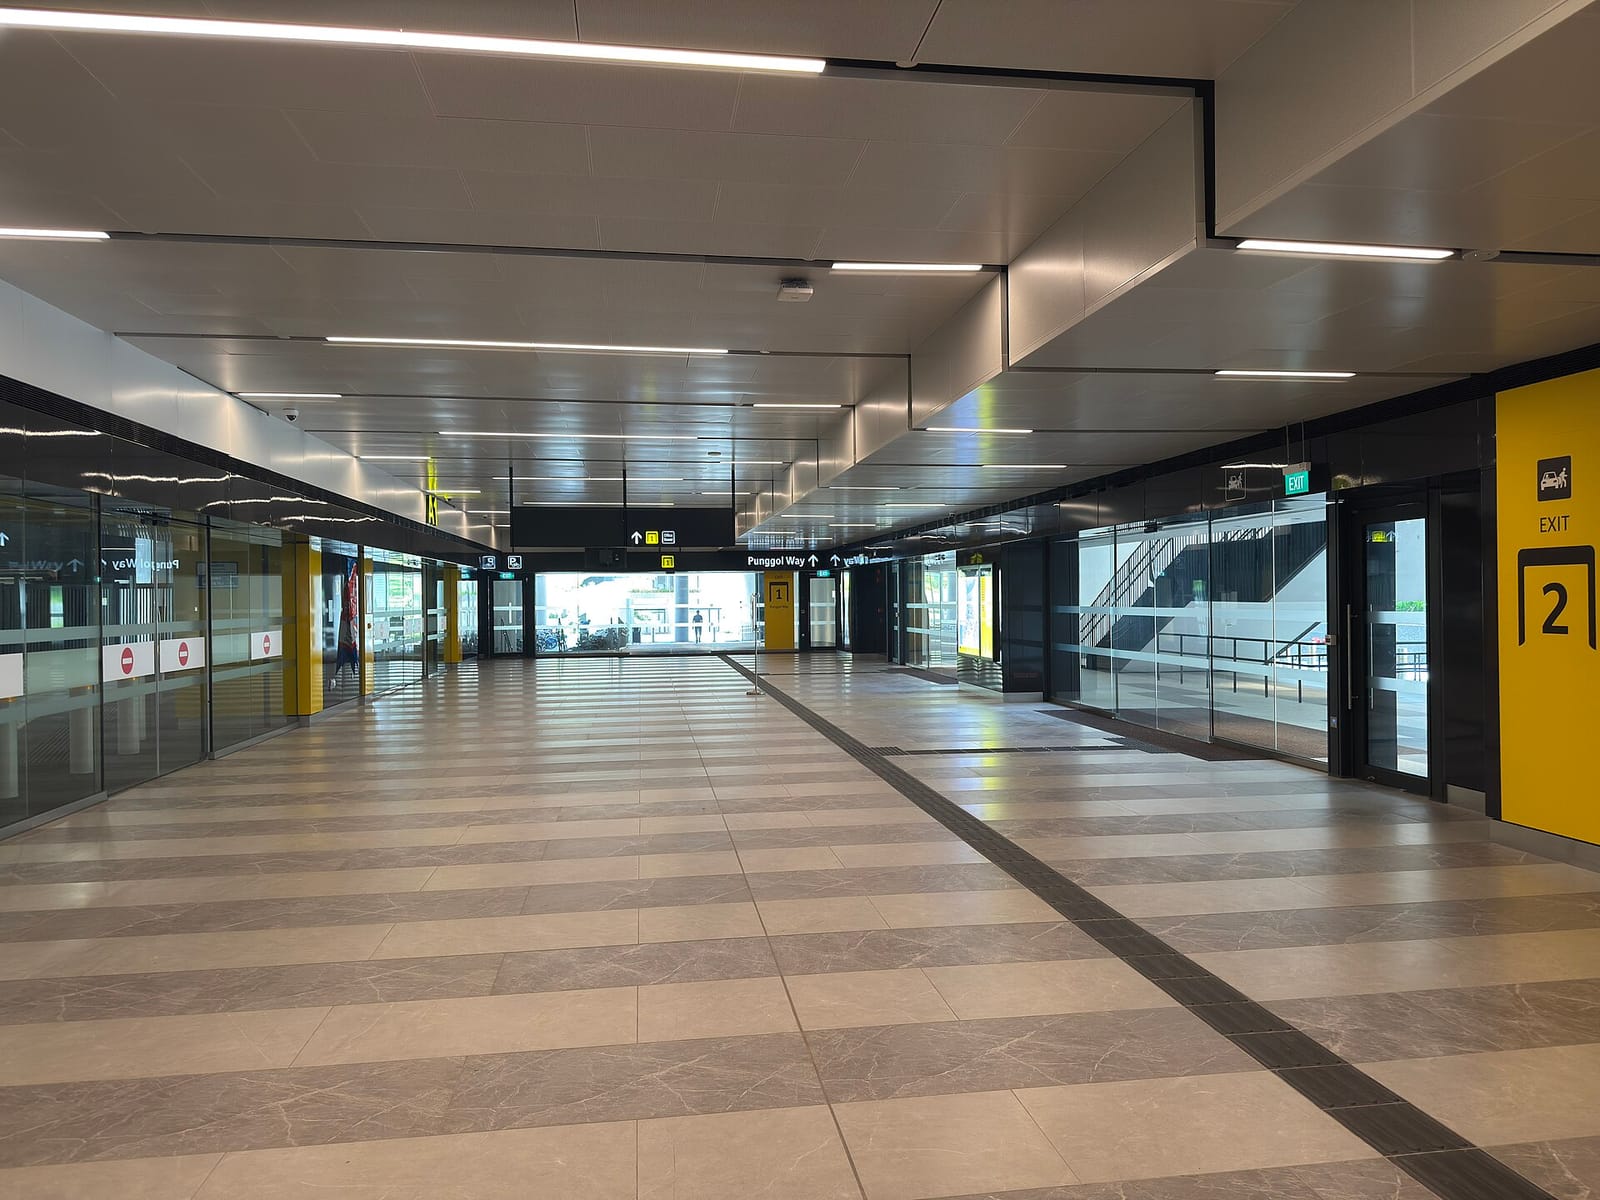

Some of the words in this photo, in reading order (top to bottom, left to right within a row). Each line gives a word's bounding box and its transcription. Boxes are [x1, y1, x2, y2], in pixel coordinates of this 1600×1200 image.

[1288, 475, 1305, 491] EXIT
[1539, 515, 1570, 533] EXIT
[747, 556, 784, 567] Punggol
[785, 556, 805, 567] Way
[775, 588, 783, 600] 1
[1542, 582, 1569, 635] 2
